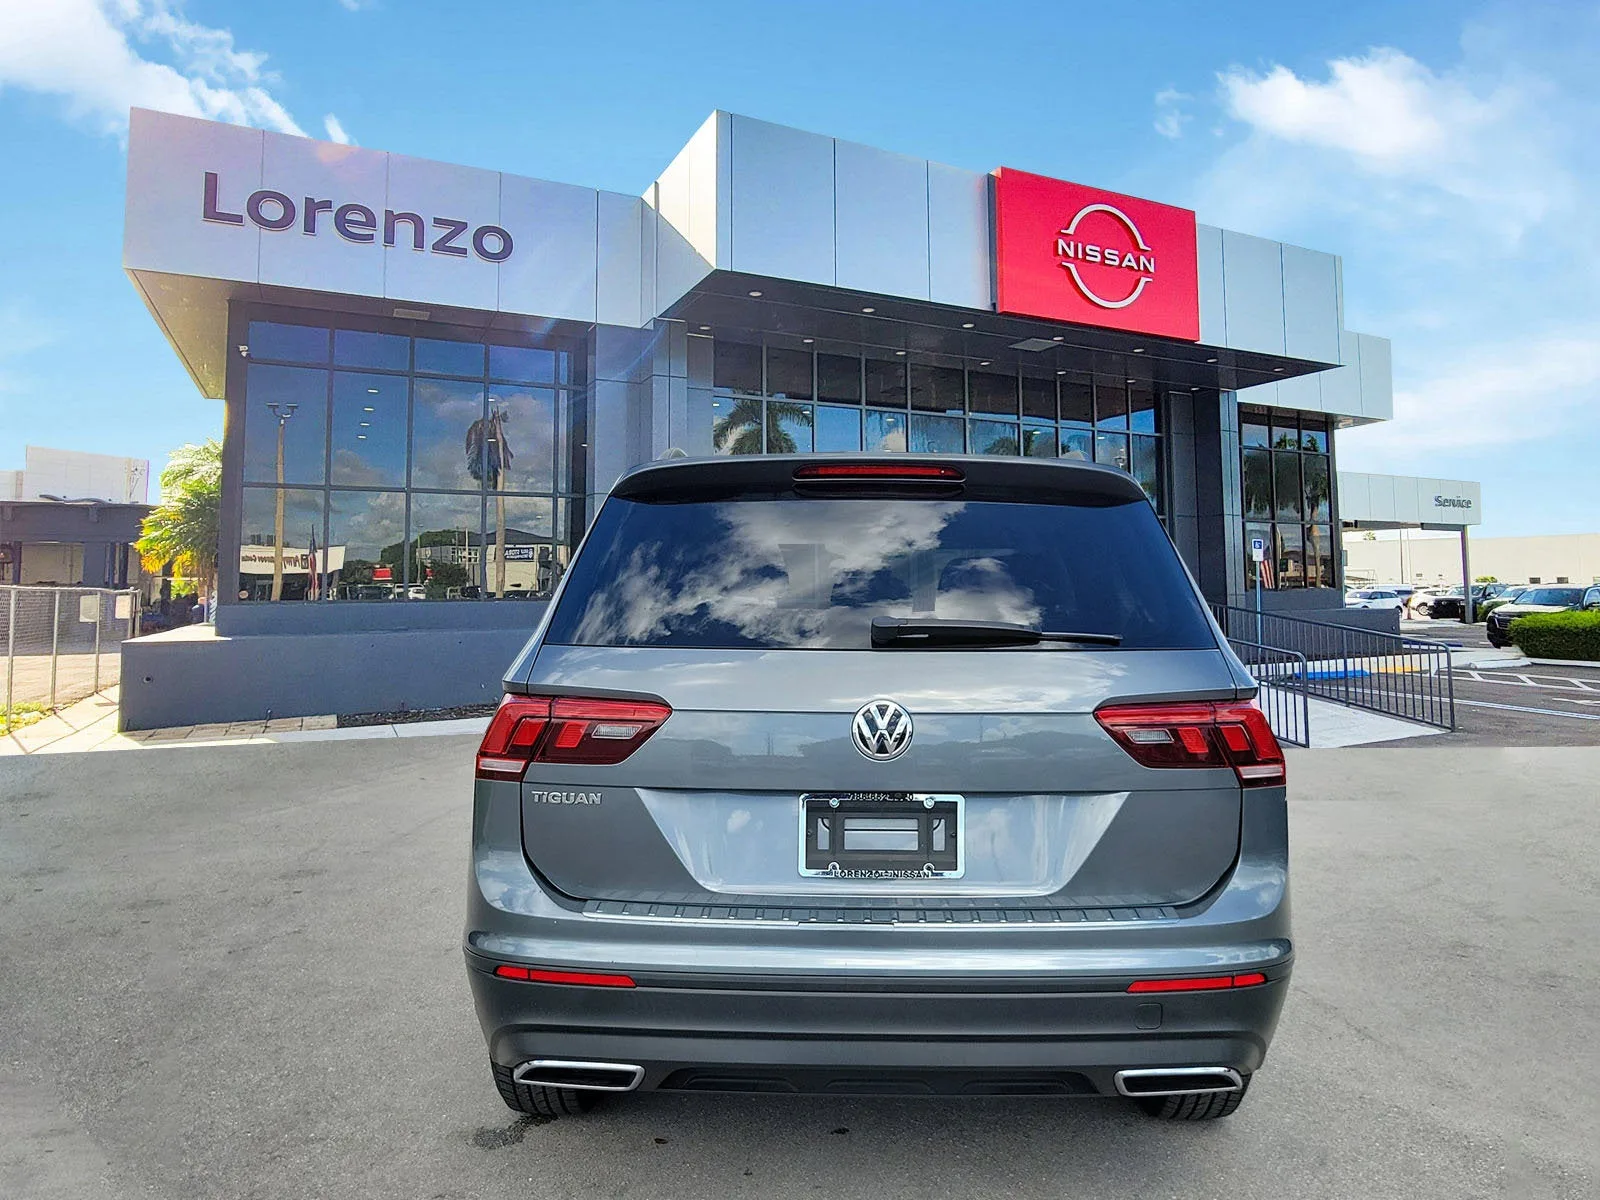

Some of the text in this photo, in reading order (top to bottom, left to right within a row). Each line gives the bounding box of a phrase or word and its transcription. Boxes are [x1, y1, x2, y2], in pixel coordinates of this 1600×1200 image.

[202, 170, 515, 263] Lorenzo
[1057, 238, 1155, 273] NISSAN
[1434, 495, 1472, 509] Service
[852, 700, 913, 759] VW
[531, 790, 602, 805] TIGUAN
[834, 869, 930, 879] LORENZO NISSAN
